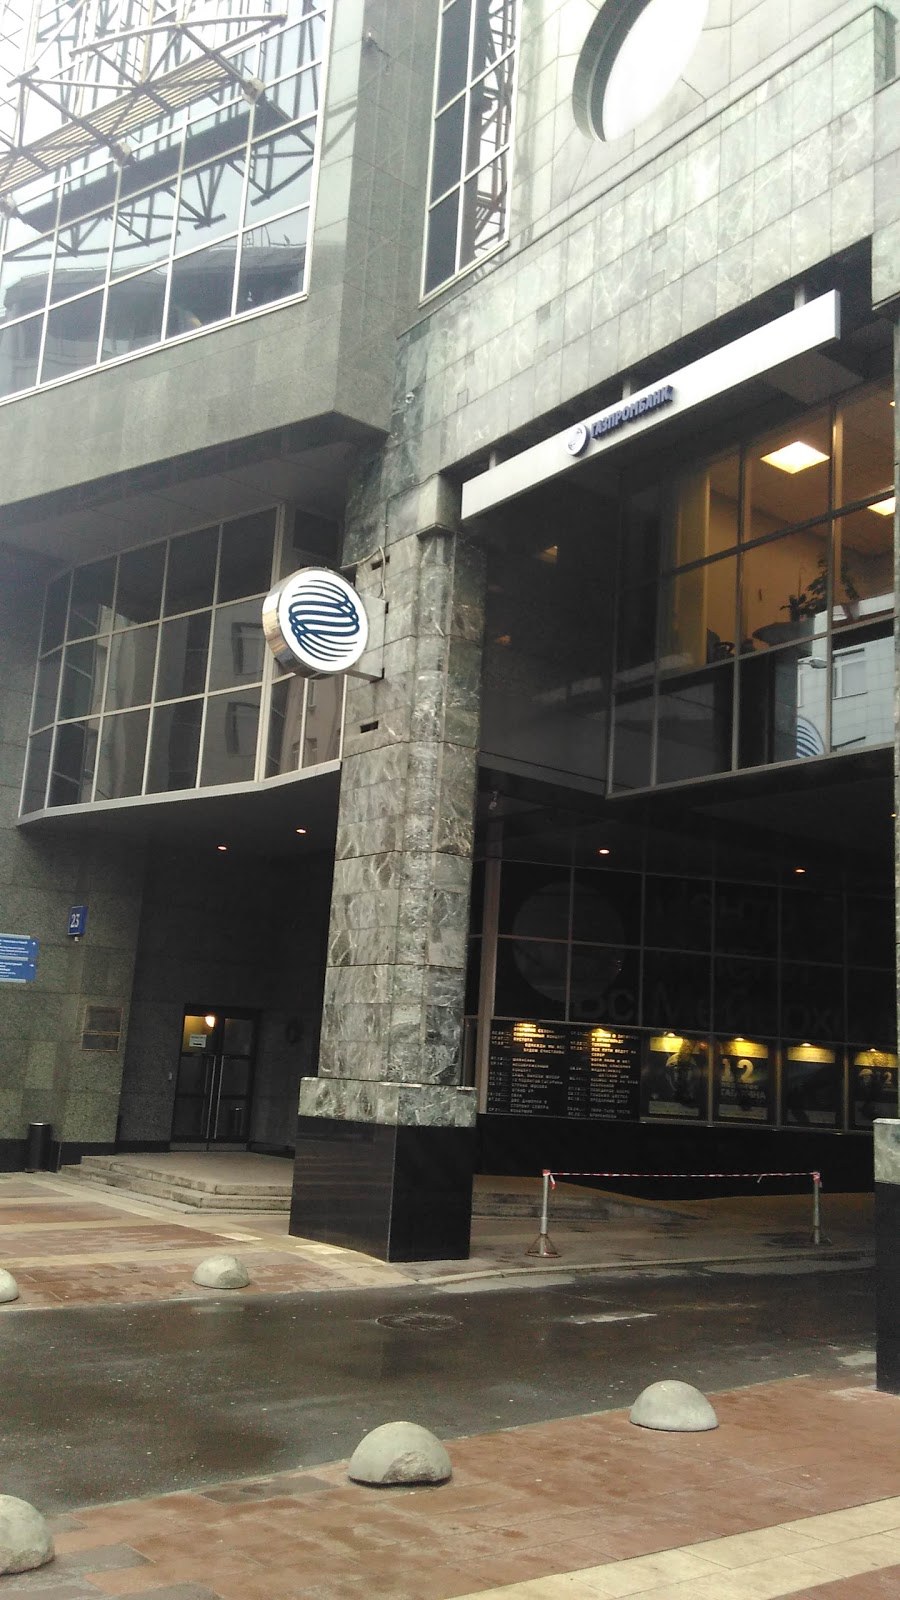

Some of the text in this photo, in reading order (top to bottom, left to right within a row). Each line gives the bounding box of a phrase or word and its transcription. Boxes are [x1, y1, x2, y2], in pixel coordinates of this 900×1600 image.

[591, 385, 673, 439] ГАЗПРОМБАНК
[70, 913, 80, 928] 23
[721, 1058, 754, 1083] 12
